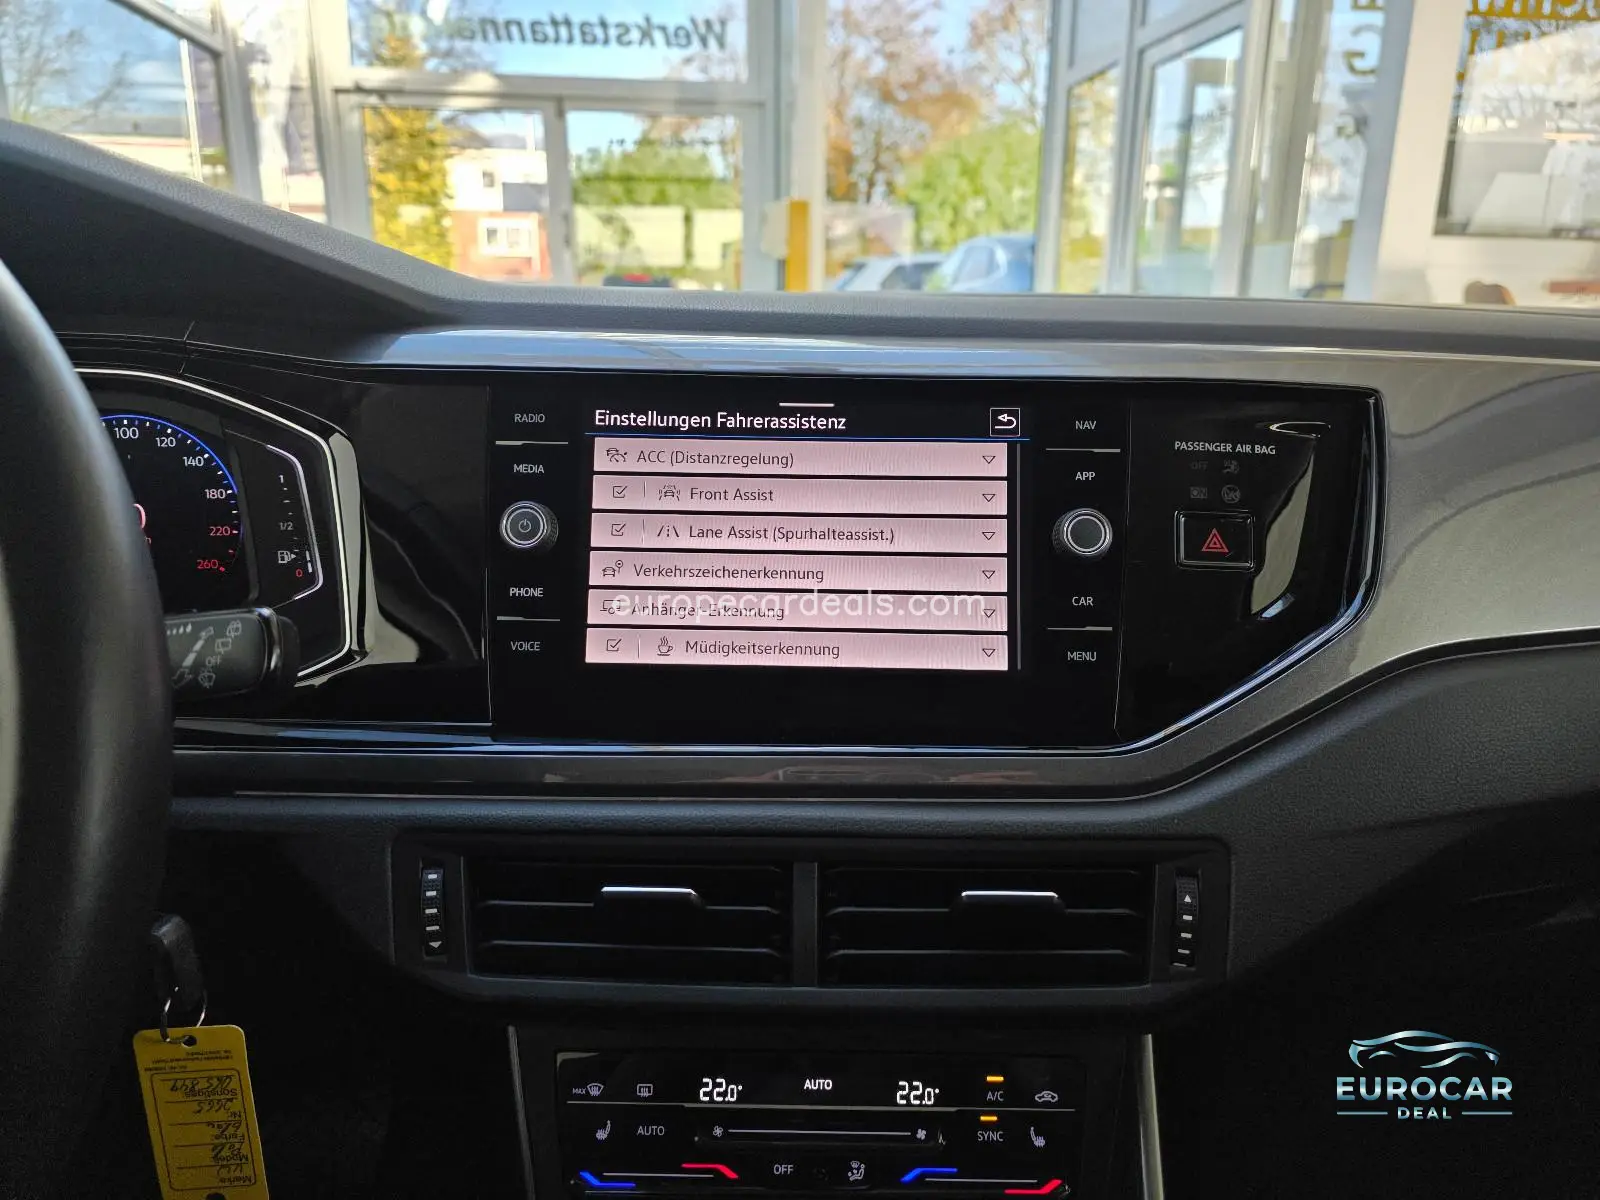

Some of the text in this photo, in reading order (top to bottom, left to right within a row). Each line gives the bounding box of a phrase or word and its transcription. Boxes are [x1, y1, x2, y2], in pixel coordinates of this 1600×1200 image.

[514, 413, 546, 423] RADIO
[595, 409, 846, 430] Einstellungen Fahrerassistenz
[1075, 420, 1097, 430] NAV
[114, 427, 139, 439] 100
[155, 437, 176, 448] 120
[1174, 441, 1276, 455] PASSENGER AIR BAG
[182, 456, 205, 467] 140
[636, 450, 794, 469] ACC (Distanzregelung)
[513, 463, 545, 474] MEDIA
[1075, 471, 1096, 481] APP
[204, 488, 226, 499] 180
[690, 487, 774, 502] Front Assist
[209, 525, 231, 536] 220
[688, 525, 895, 544] Lane Assist (Spurhalteassist.)
[196, 559, 218, 570] 260
[296, 568, 303, 578] 0
[634, 563, 824, 583] Verkehrszeichenerkennung
[509, 587, 544, 597] PHONE
[1072, 596, 1094, 607] CAR
[510, 641, 541, 651] VOICE
[685, 640, 841, 660] Müdigkeitserkennung
[1067, 651, 1097, 662] MENU
[803, 1079, 833, 1091] AUTO
[572, 1087, 586, 1095] MAX
[986, 1091, 1005, 1102] A/C
[637, 1125, 665, 1137] AUTO
[977, 1130, 1004, 1142] SYNC
[773, 1164, 794, 1175] OFF
